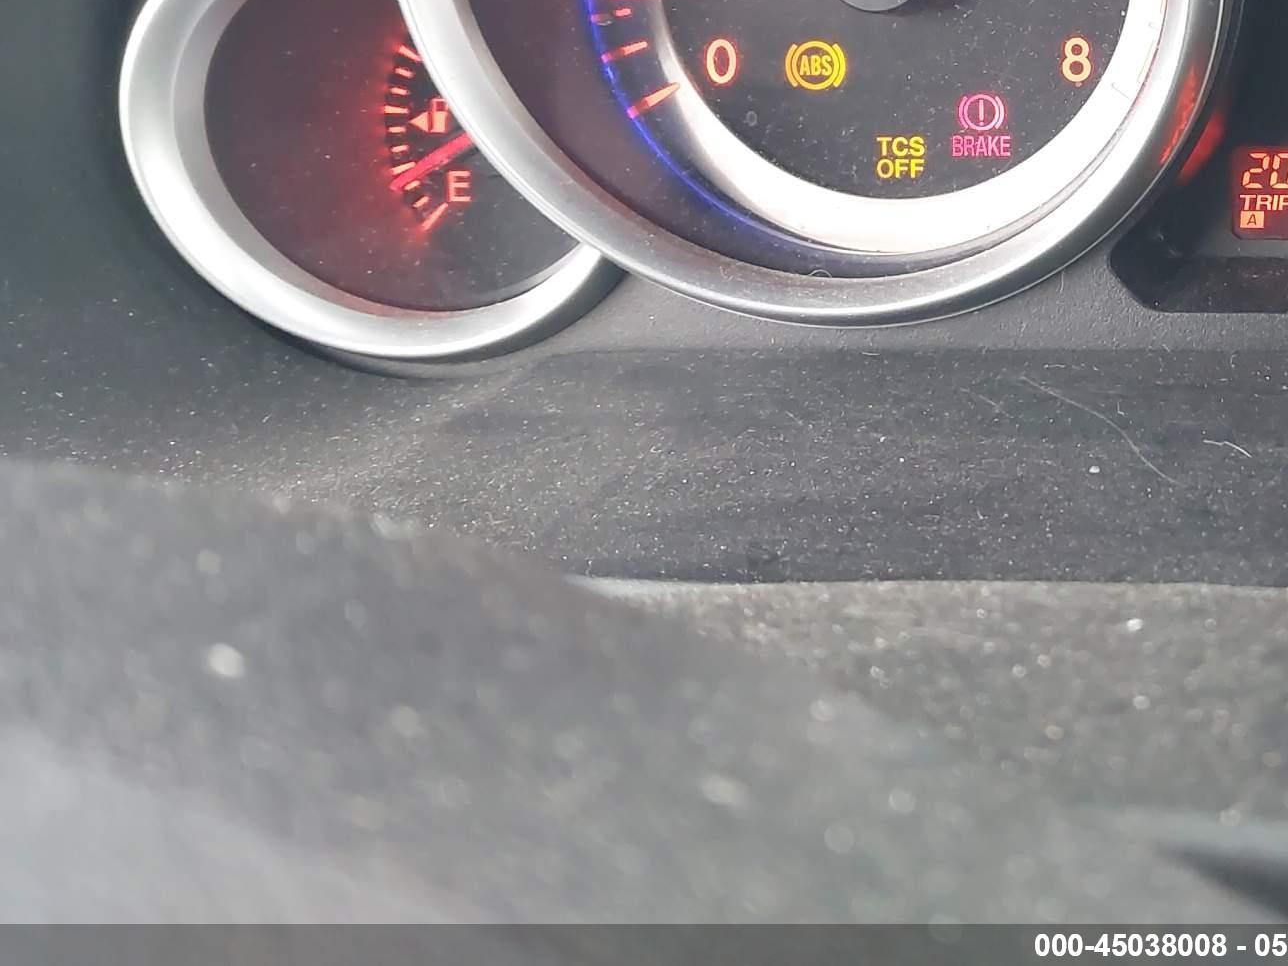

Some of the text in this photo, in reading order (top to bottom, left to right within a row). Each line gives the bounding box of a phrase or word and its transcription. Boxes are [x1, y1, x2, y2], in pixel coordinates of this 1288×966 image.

[706, 40, 737, 83] 0
[799, 54, 833, 76] ABS
[1062, 38, 1092, 81] 8
[876, 136, 926, 157] TCS
[952, 135, 1011, 158] BRAKE
[876, 158, 925, 179] OFF
[448, 170, 472, 203] E
